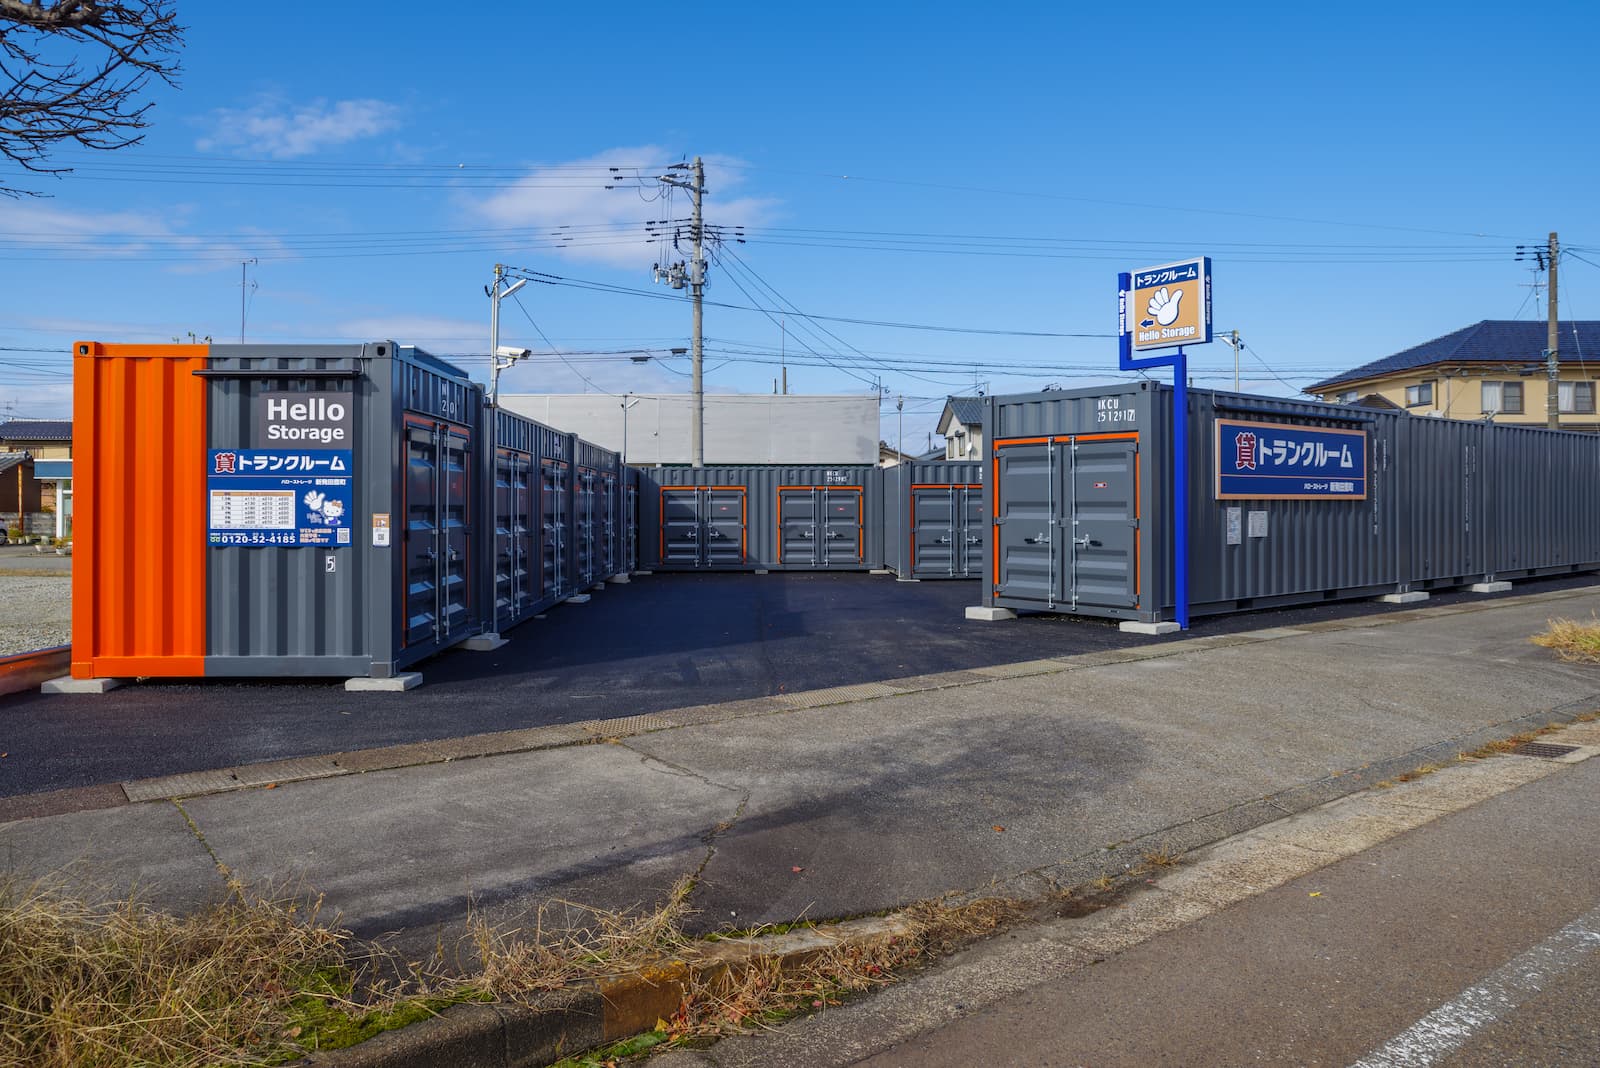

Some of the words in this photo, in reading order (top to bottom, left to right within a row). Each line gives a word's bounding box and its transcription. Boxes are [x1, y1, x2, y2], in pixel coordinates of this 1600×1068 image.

[1137, 267, 1197, 287] トランクルーム
[1139, 331, 1160, 342] Hello
[1162, 326, 1195, 339] Storage
[267, 398, 345, 421] Hello
[267, 424, 345, 443] Storage
[221, 535, 296, 544] 0120-52-4185
